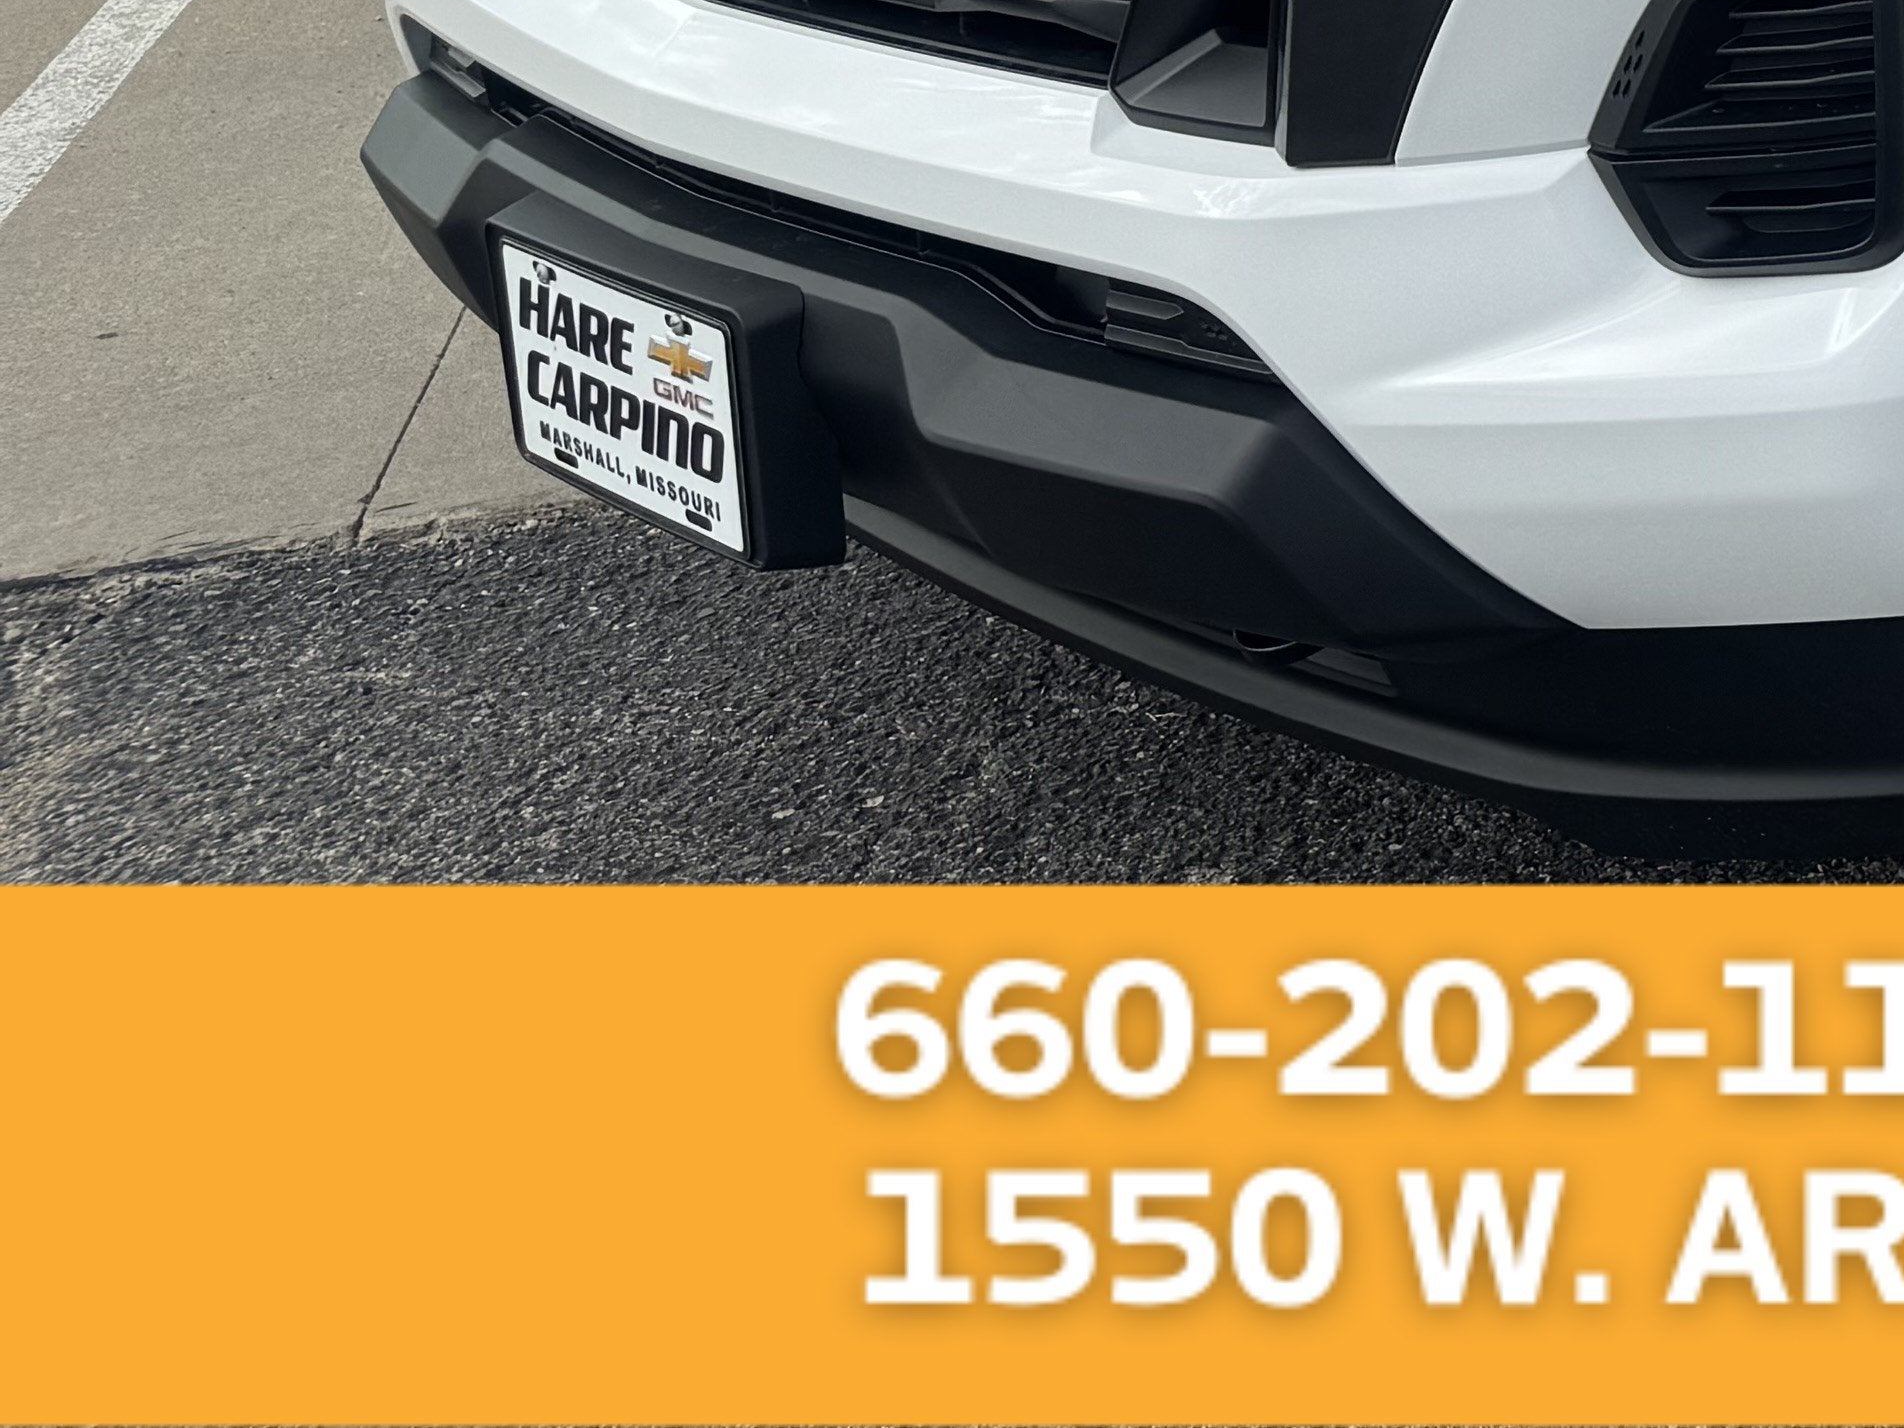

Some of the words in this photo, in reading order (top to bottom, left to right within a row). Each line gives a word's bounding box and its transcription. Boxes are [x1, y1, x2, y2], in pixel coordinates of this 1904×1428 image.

[518, 276, 635, 375] HARE
[527, 350, 725, 484] CARPINO
[653, 377, 714, 419] GMC
[539, 420, 632, 485] MARSHALL,
[635, 465, 722, 523] MISSOURI
